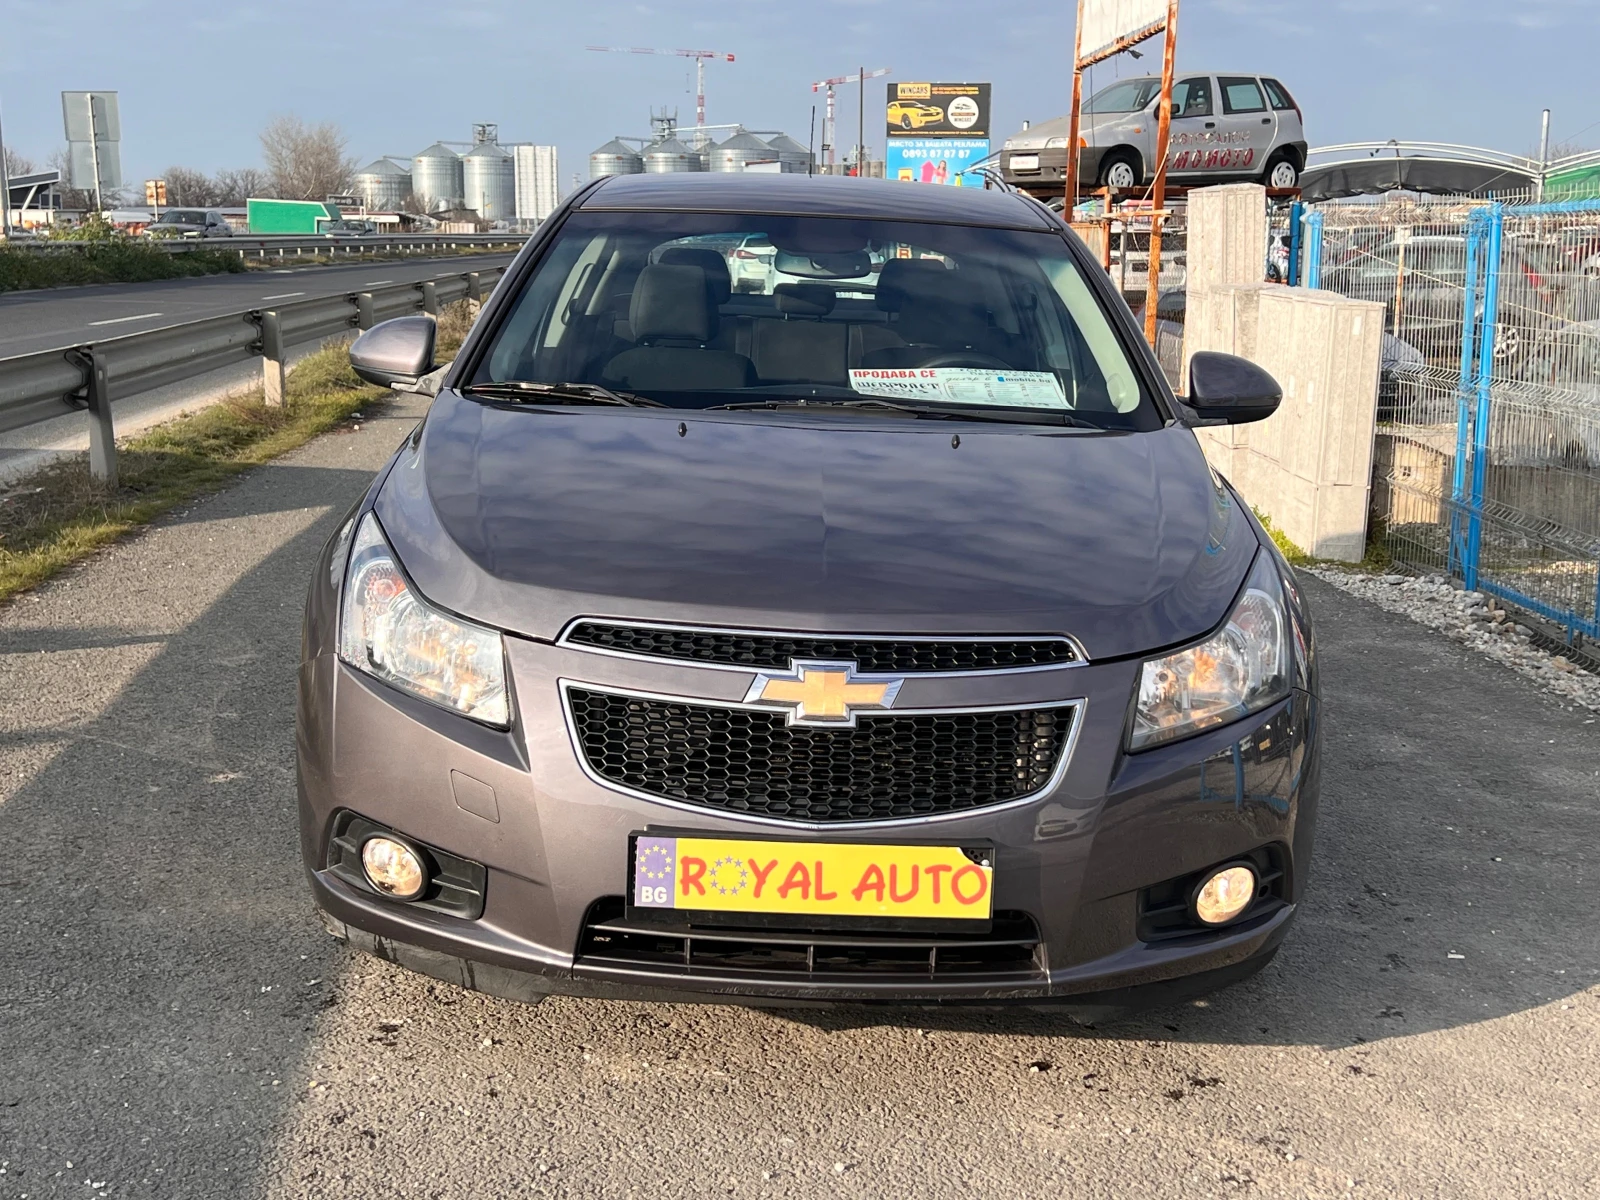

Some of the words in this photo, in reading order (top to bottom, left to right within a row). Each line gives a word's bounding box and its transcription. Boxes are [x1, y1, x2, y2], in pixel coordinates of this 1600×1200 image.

[900, 86, 928, 95] WINCARS
[902, 149, 927, 158] 0893
[930, 149, 941, 158] 87
[944, 149, 956, 158] 87
[958, 149, 970, 158] 87
[853, 370, 917, 379] ПРОДАВА
[920, 370, 937, 378] СЕ
[680, 855, 837, 900] ROYAL
[851, 863, 988, 905] AUTO
[641, 886, 667, 903] BG
